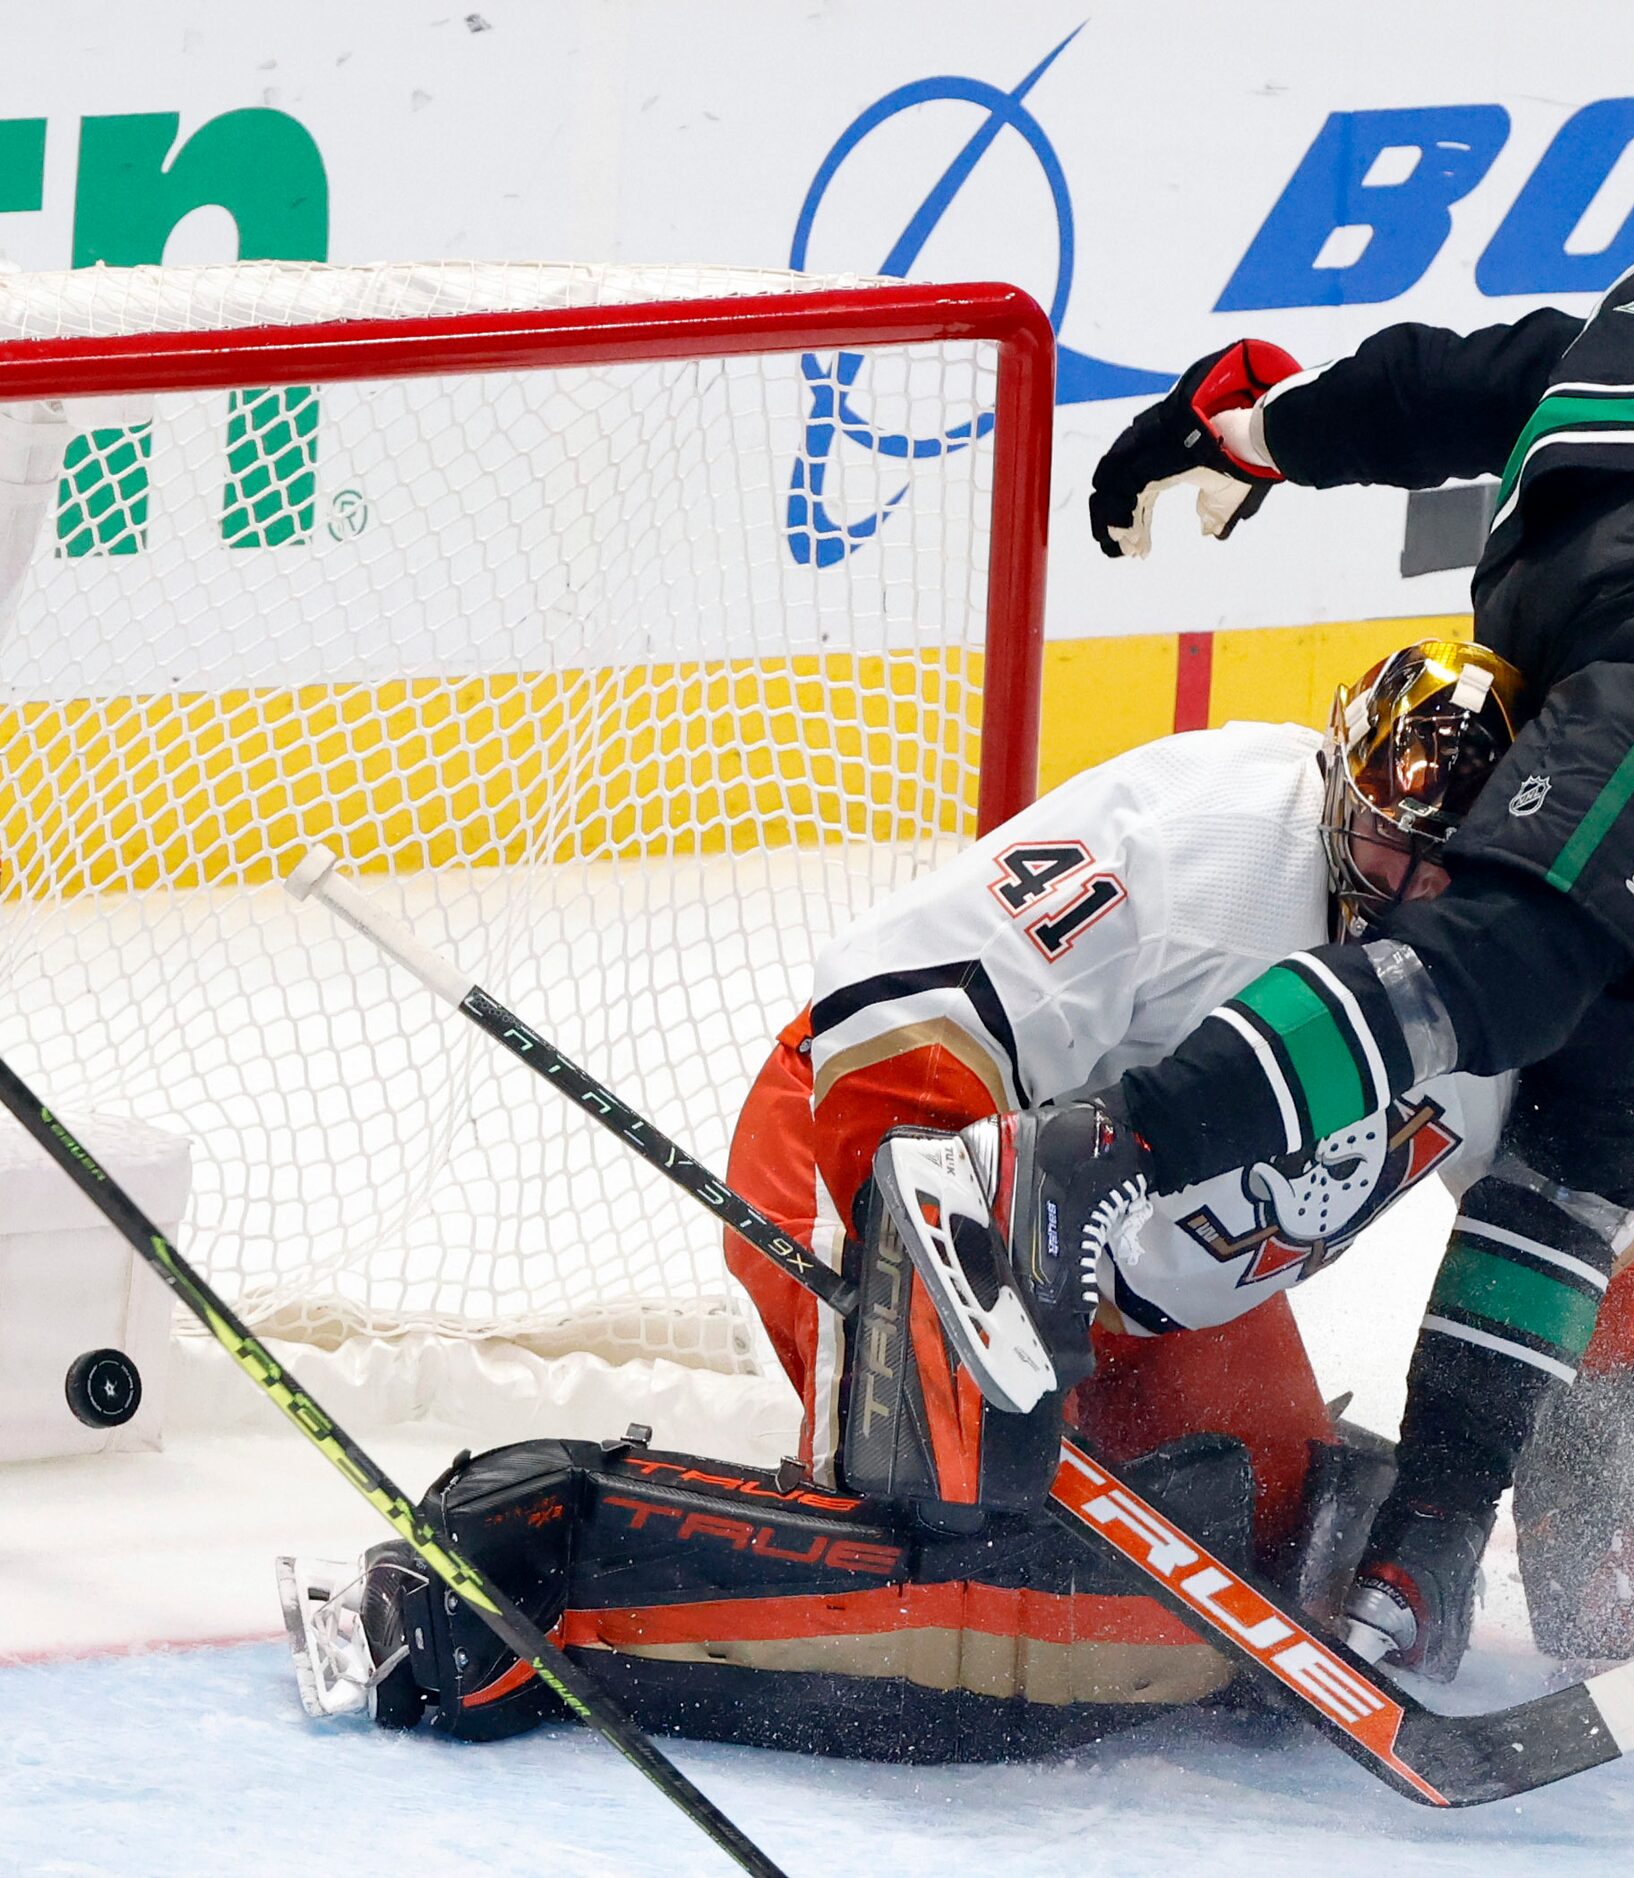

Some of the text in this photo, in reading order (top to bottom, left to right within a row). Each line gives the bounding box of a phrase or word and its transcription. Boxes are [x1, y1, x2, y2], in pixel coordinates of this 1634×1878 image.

[987, 839, 1128, 964] 41
[464, 991, 815, 1275] CATALYST 9X
[862, 1194, 904, 1439] TRUE
[602, 1495, 902, 1577] TRUE
[622, 1457, 864, 1512] TRUE
